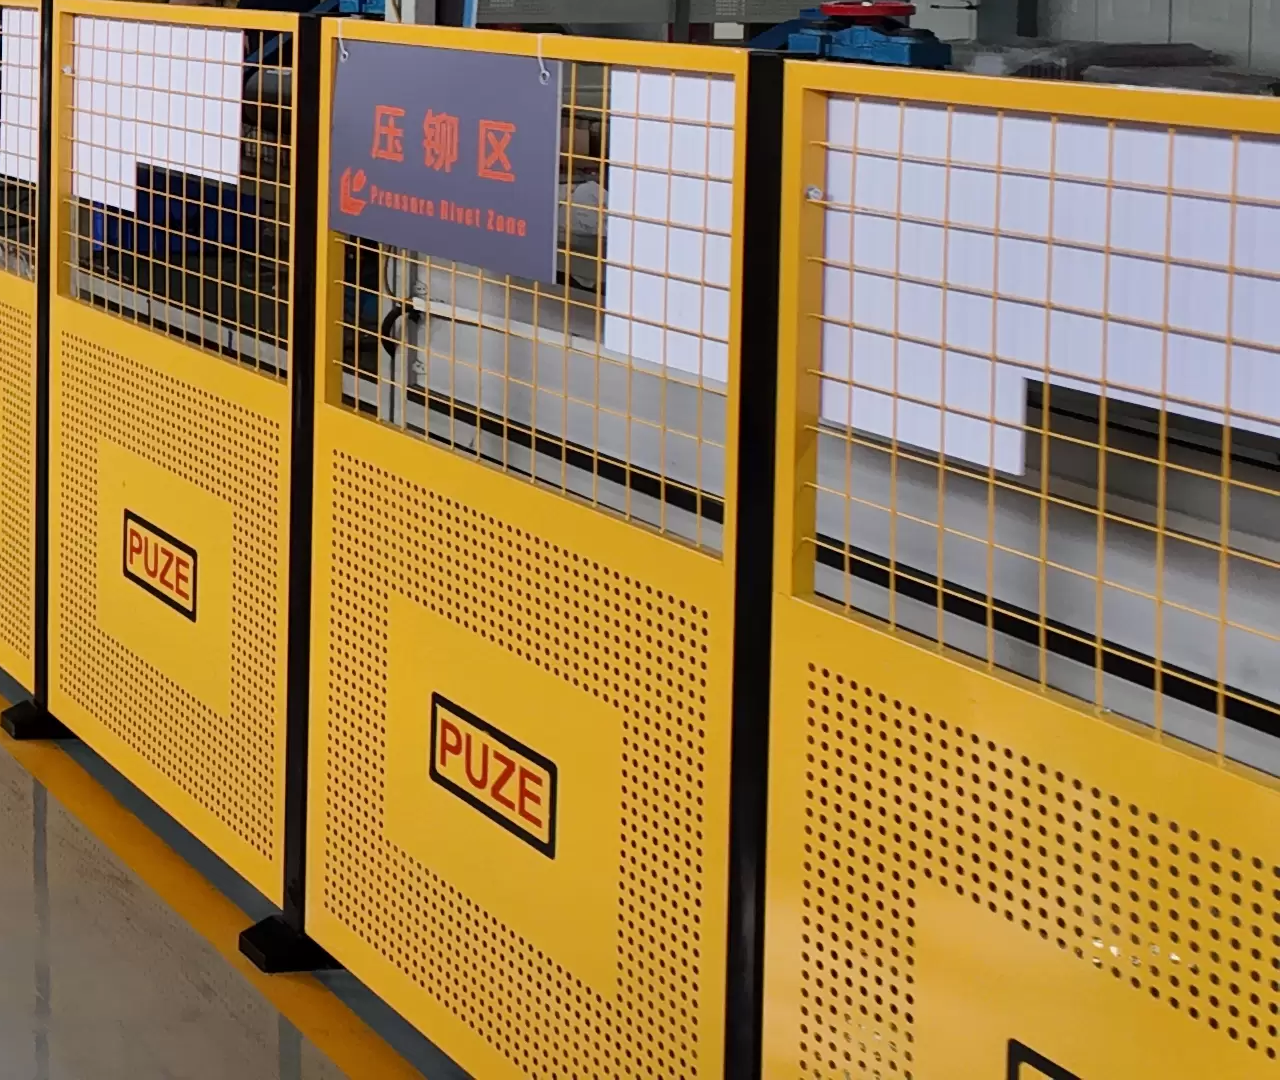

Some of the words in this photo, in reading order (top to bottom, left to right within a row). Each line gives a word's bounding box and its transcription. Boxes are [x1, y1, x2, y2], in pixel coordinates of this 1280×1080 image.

[372, 104, 517, 183] 压铆区
[371, 185, 435, 217] Pressure
[440, 199, 481, 228] Rivet
[486, 208, 528, 237] Zone
[130, 528, 190, 601] PUZE
[440, 718, 543, 829] PUZE
